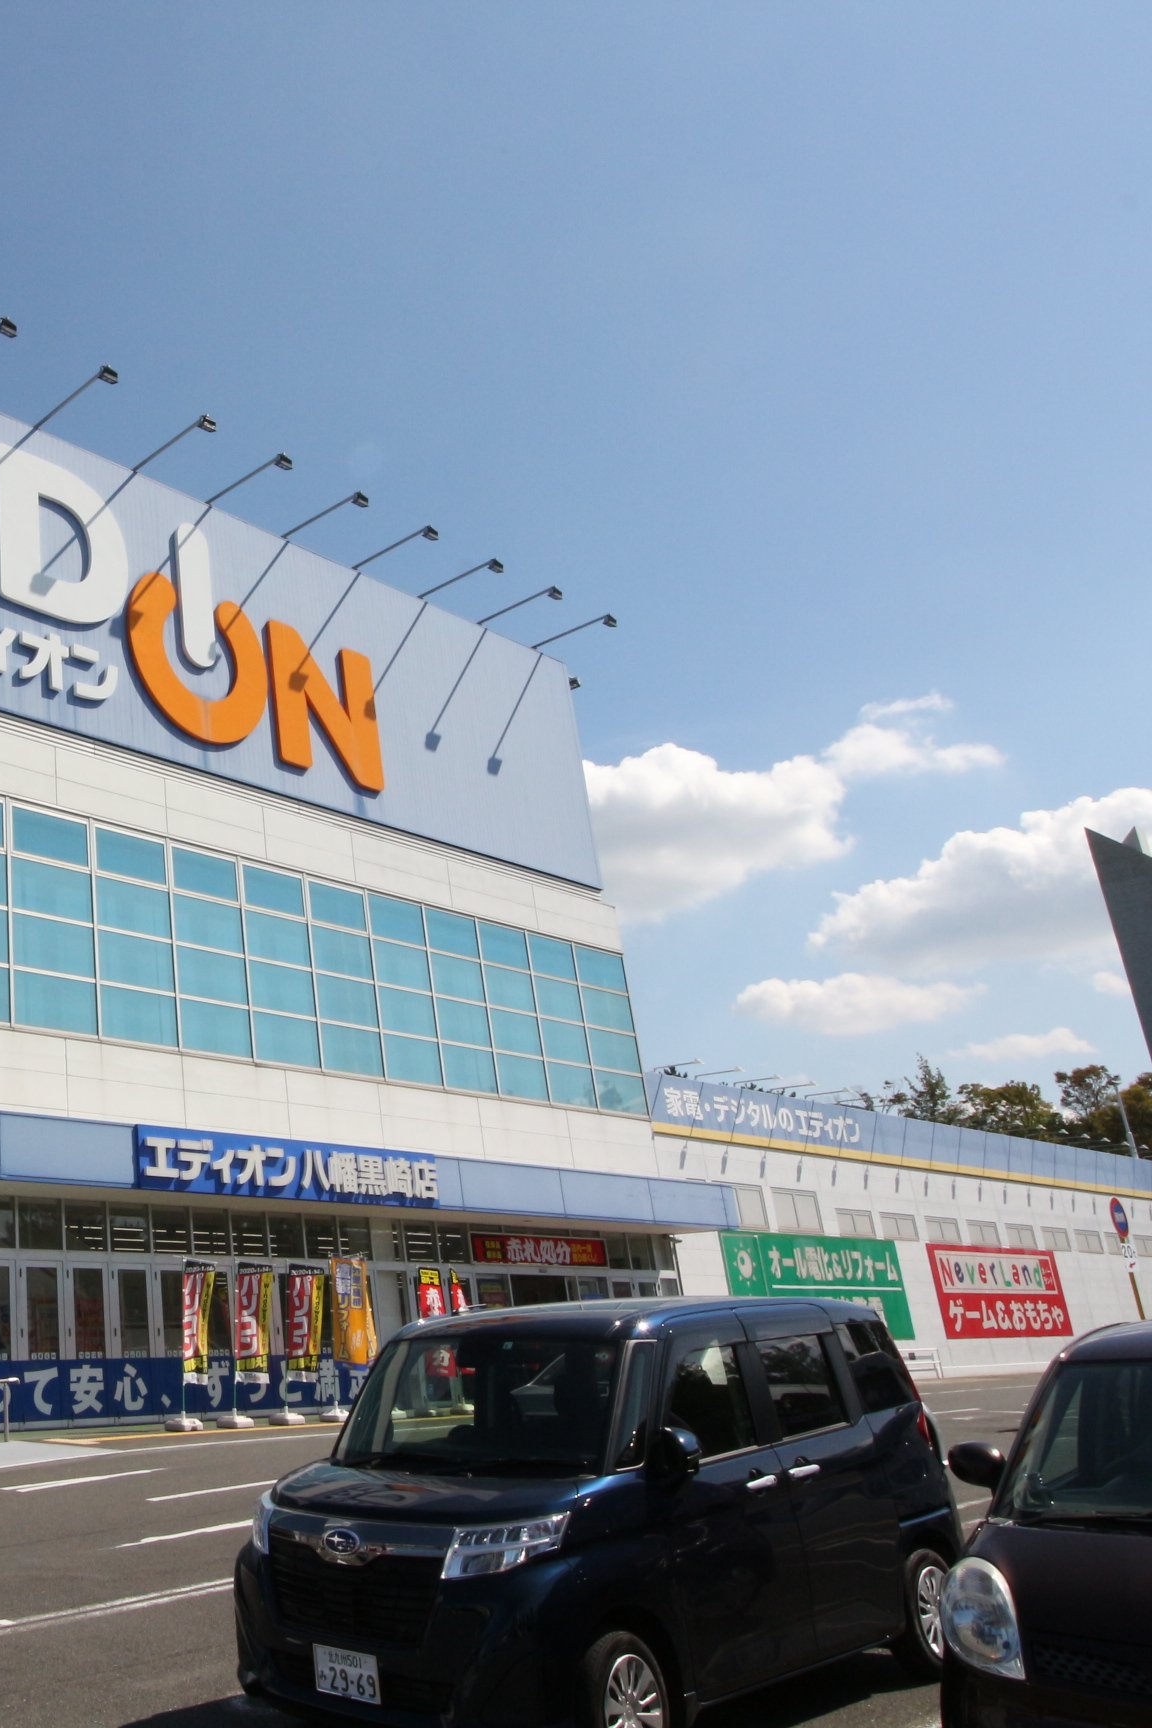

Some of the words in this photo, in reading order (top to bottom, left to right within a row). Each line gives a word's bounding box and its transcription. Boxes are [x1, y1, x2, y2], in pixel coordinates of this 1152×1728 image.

[664, 1087, 861, 1143] 家電・デジタルのエディオン
[768, 1246, 900, 1282] オール電化&リフォーム
[939, 1257, 1043, 1288] NeverLand
[183, 1273, 204, 1357] パソコン
[240, 1273, 260, 1356] パソコン
[292, 1275, 312, 1356] パソコン
[949, 1299, 1065, 1333] ゲーム&おもちゃ
[329, 1666, 377, 1698] 29-69
